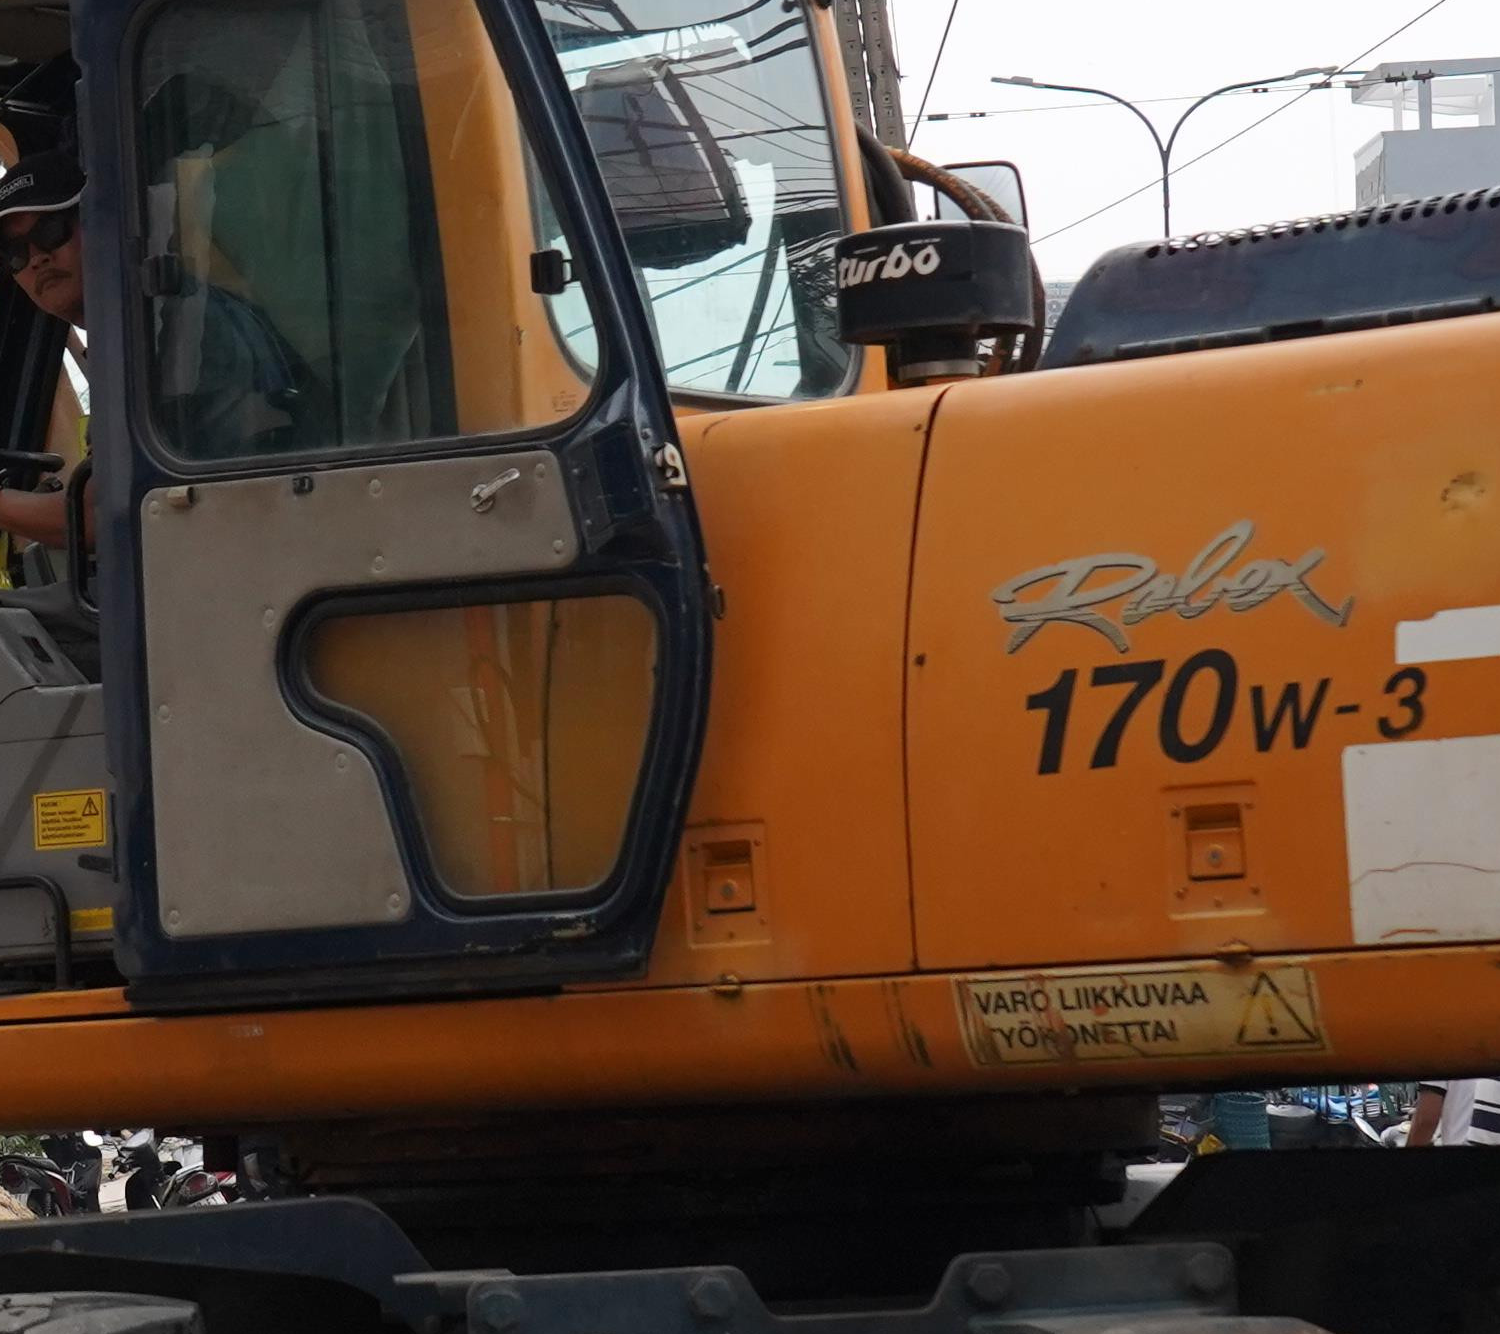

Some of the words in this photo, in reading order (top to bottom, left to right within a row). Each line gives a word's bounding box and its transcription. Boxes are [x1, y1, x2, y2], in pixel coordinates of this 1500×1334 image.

[838, 242, 941, 289] turbo
[974, 988, 1050, 1015] VARO
[1060, 981, 1210, 1012] LIIKKUVAA
